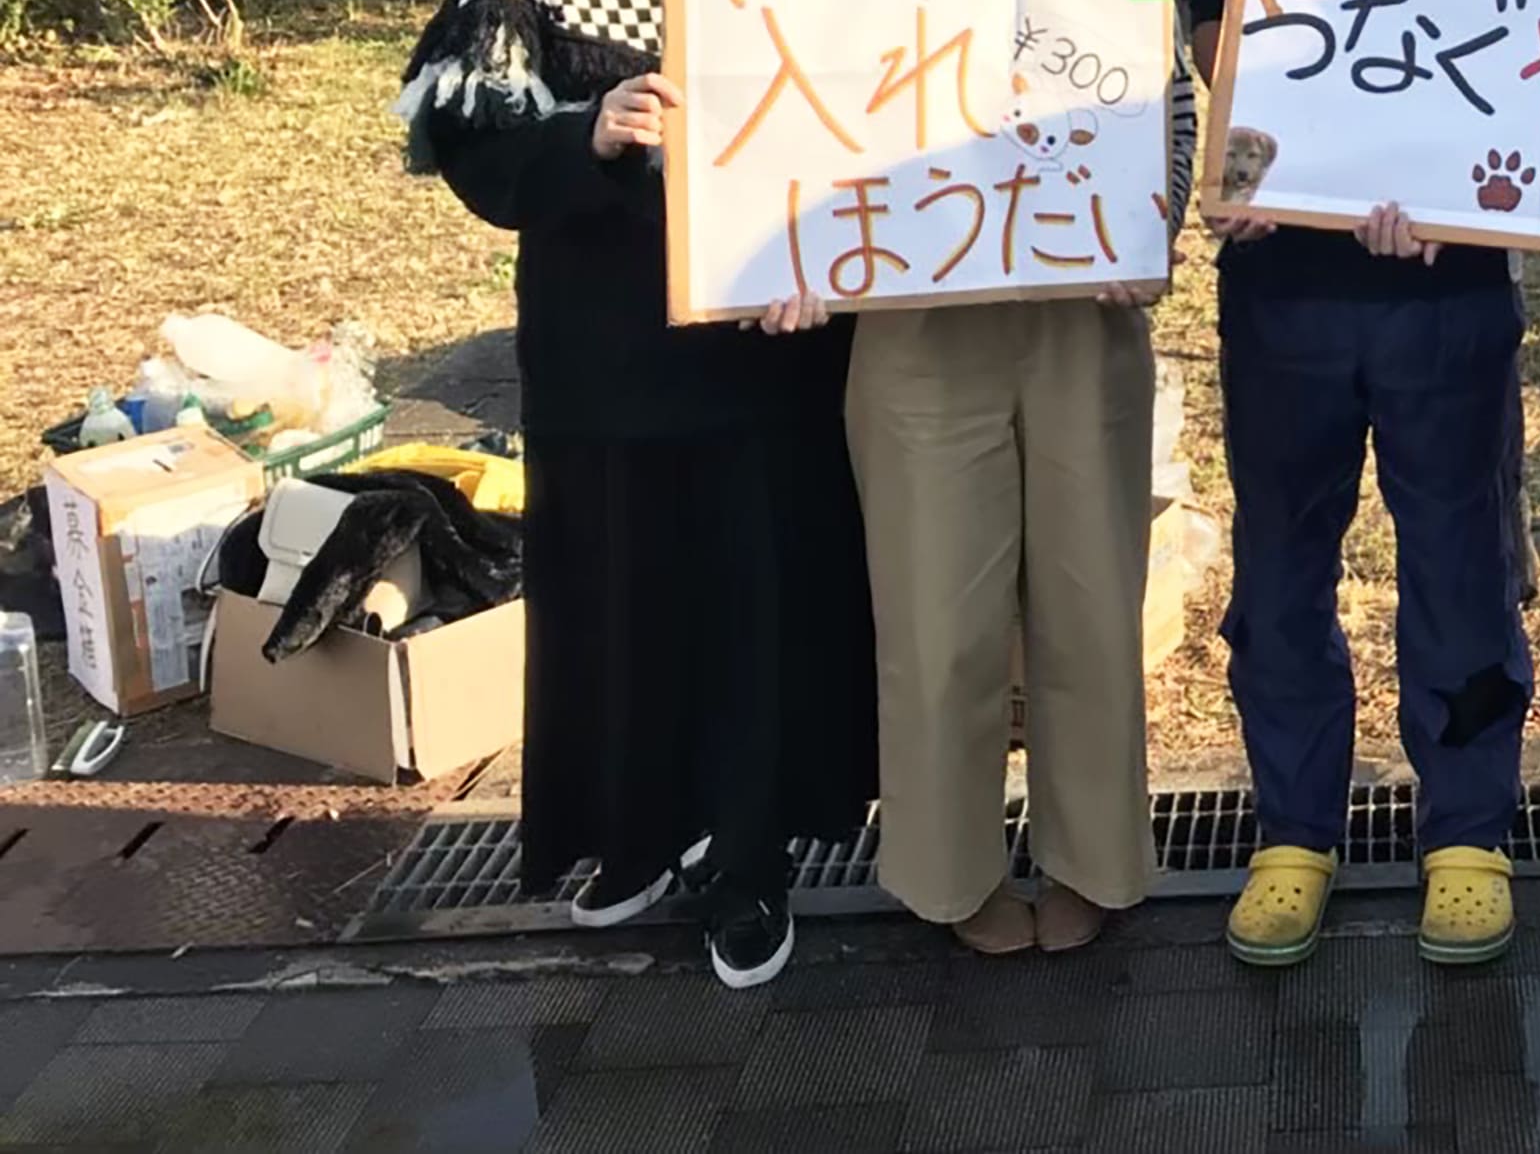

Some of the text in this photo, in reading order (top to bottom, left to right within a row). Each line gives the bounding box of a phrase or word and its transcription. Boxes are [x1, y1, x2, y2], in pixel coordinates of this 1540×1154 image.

[712, 4, 998, 167] 入れ
[1013, 17, 1129, 105] ¥300
[787, 163, 1168, 298] ほうだい
